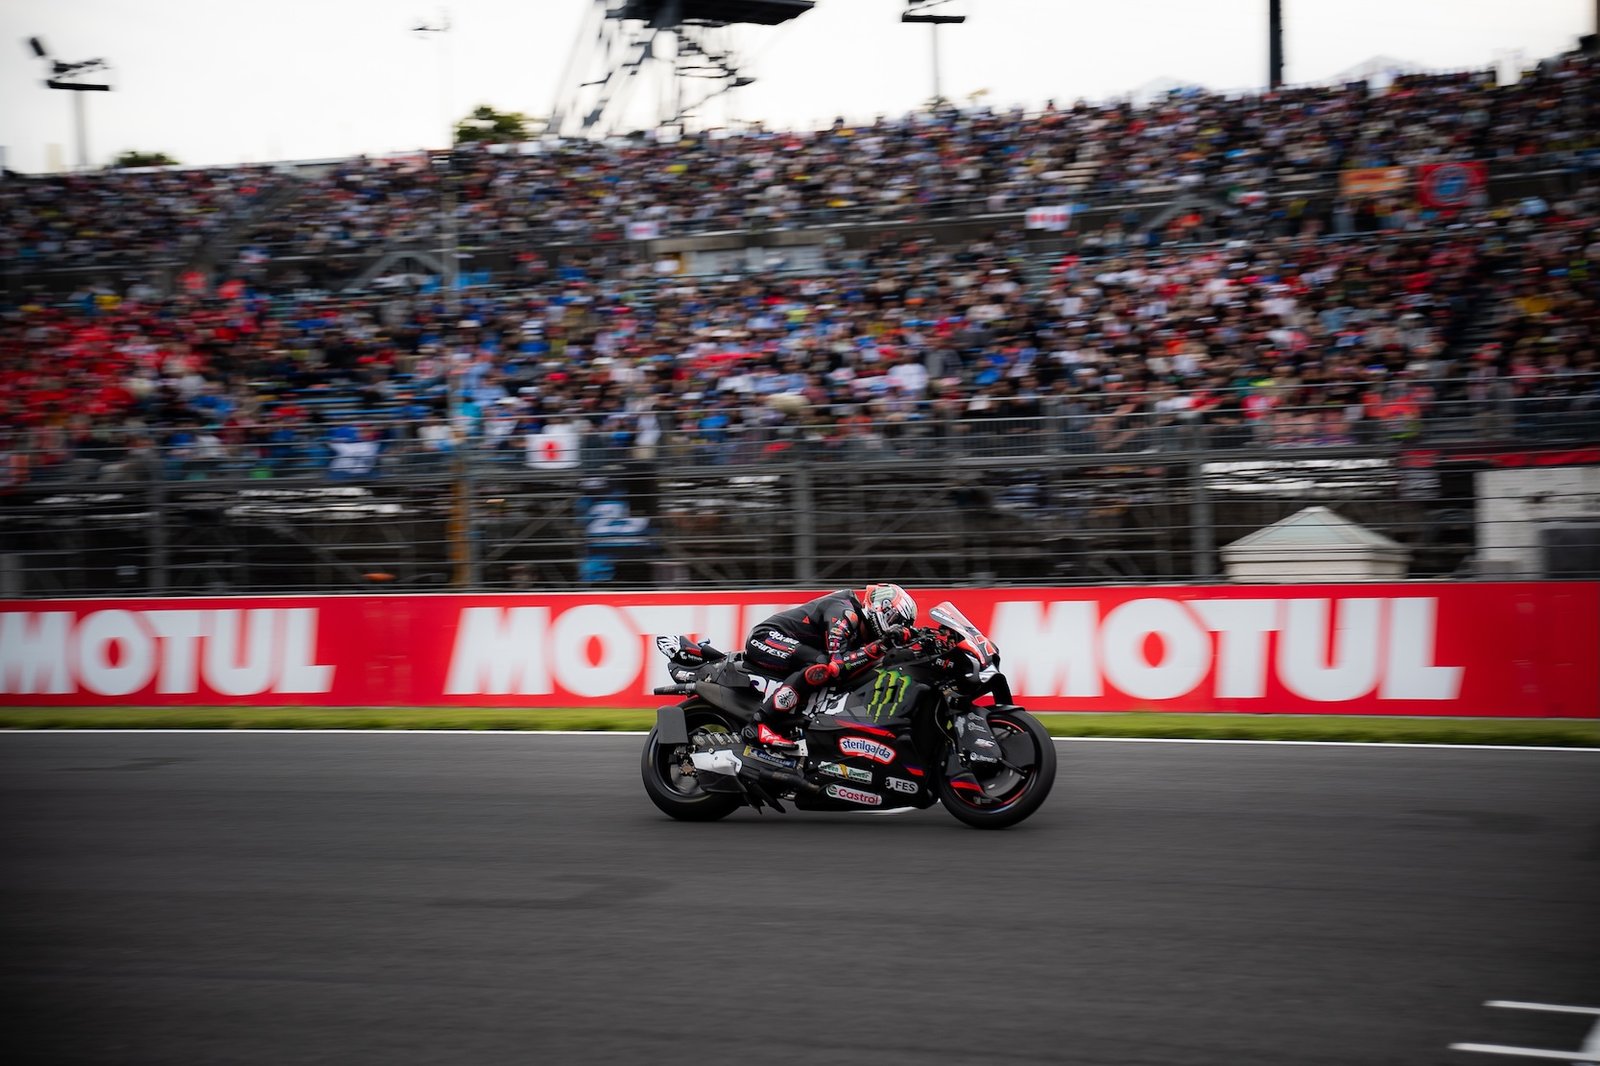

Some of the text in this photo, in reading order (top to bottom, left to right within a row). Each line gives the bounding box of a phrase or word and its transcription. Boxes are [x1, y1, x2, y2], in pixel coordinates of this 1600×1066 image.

[0, 607, 337, 695] MOTUL
[444, 604, 800, 698] MOT
[986, 597, 1466, 701] MOTUL
[758, 753, 792, 767] MICHELIN
[841, 737, 892, 760] sterilgarda
[838, 787, 880, 805] Castrol
[894, 780, 917, 793] FES
